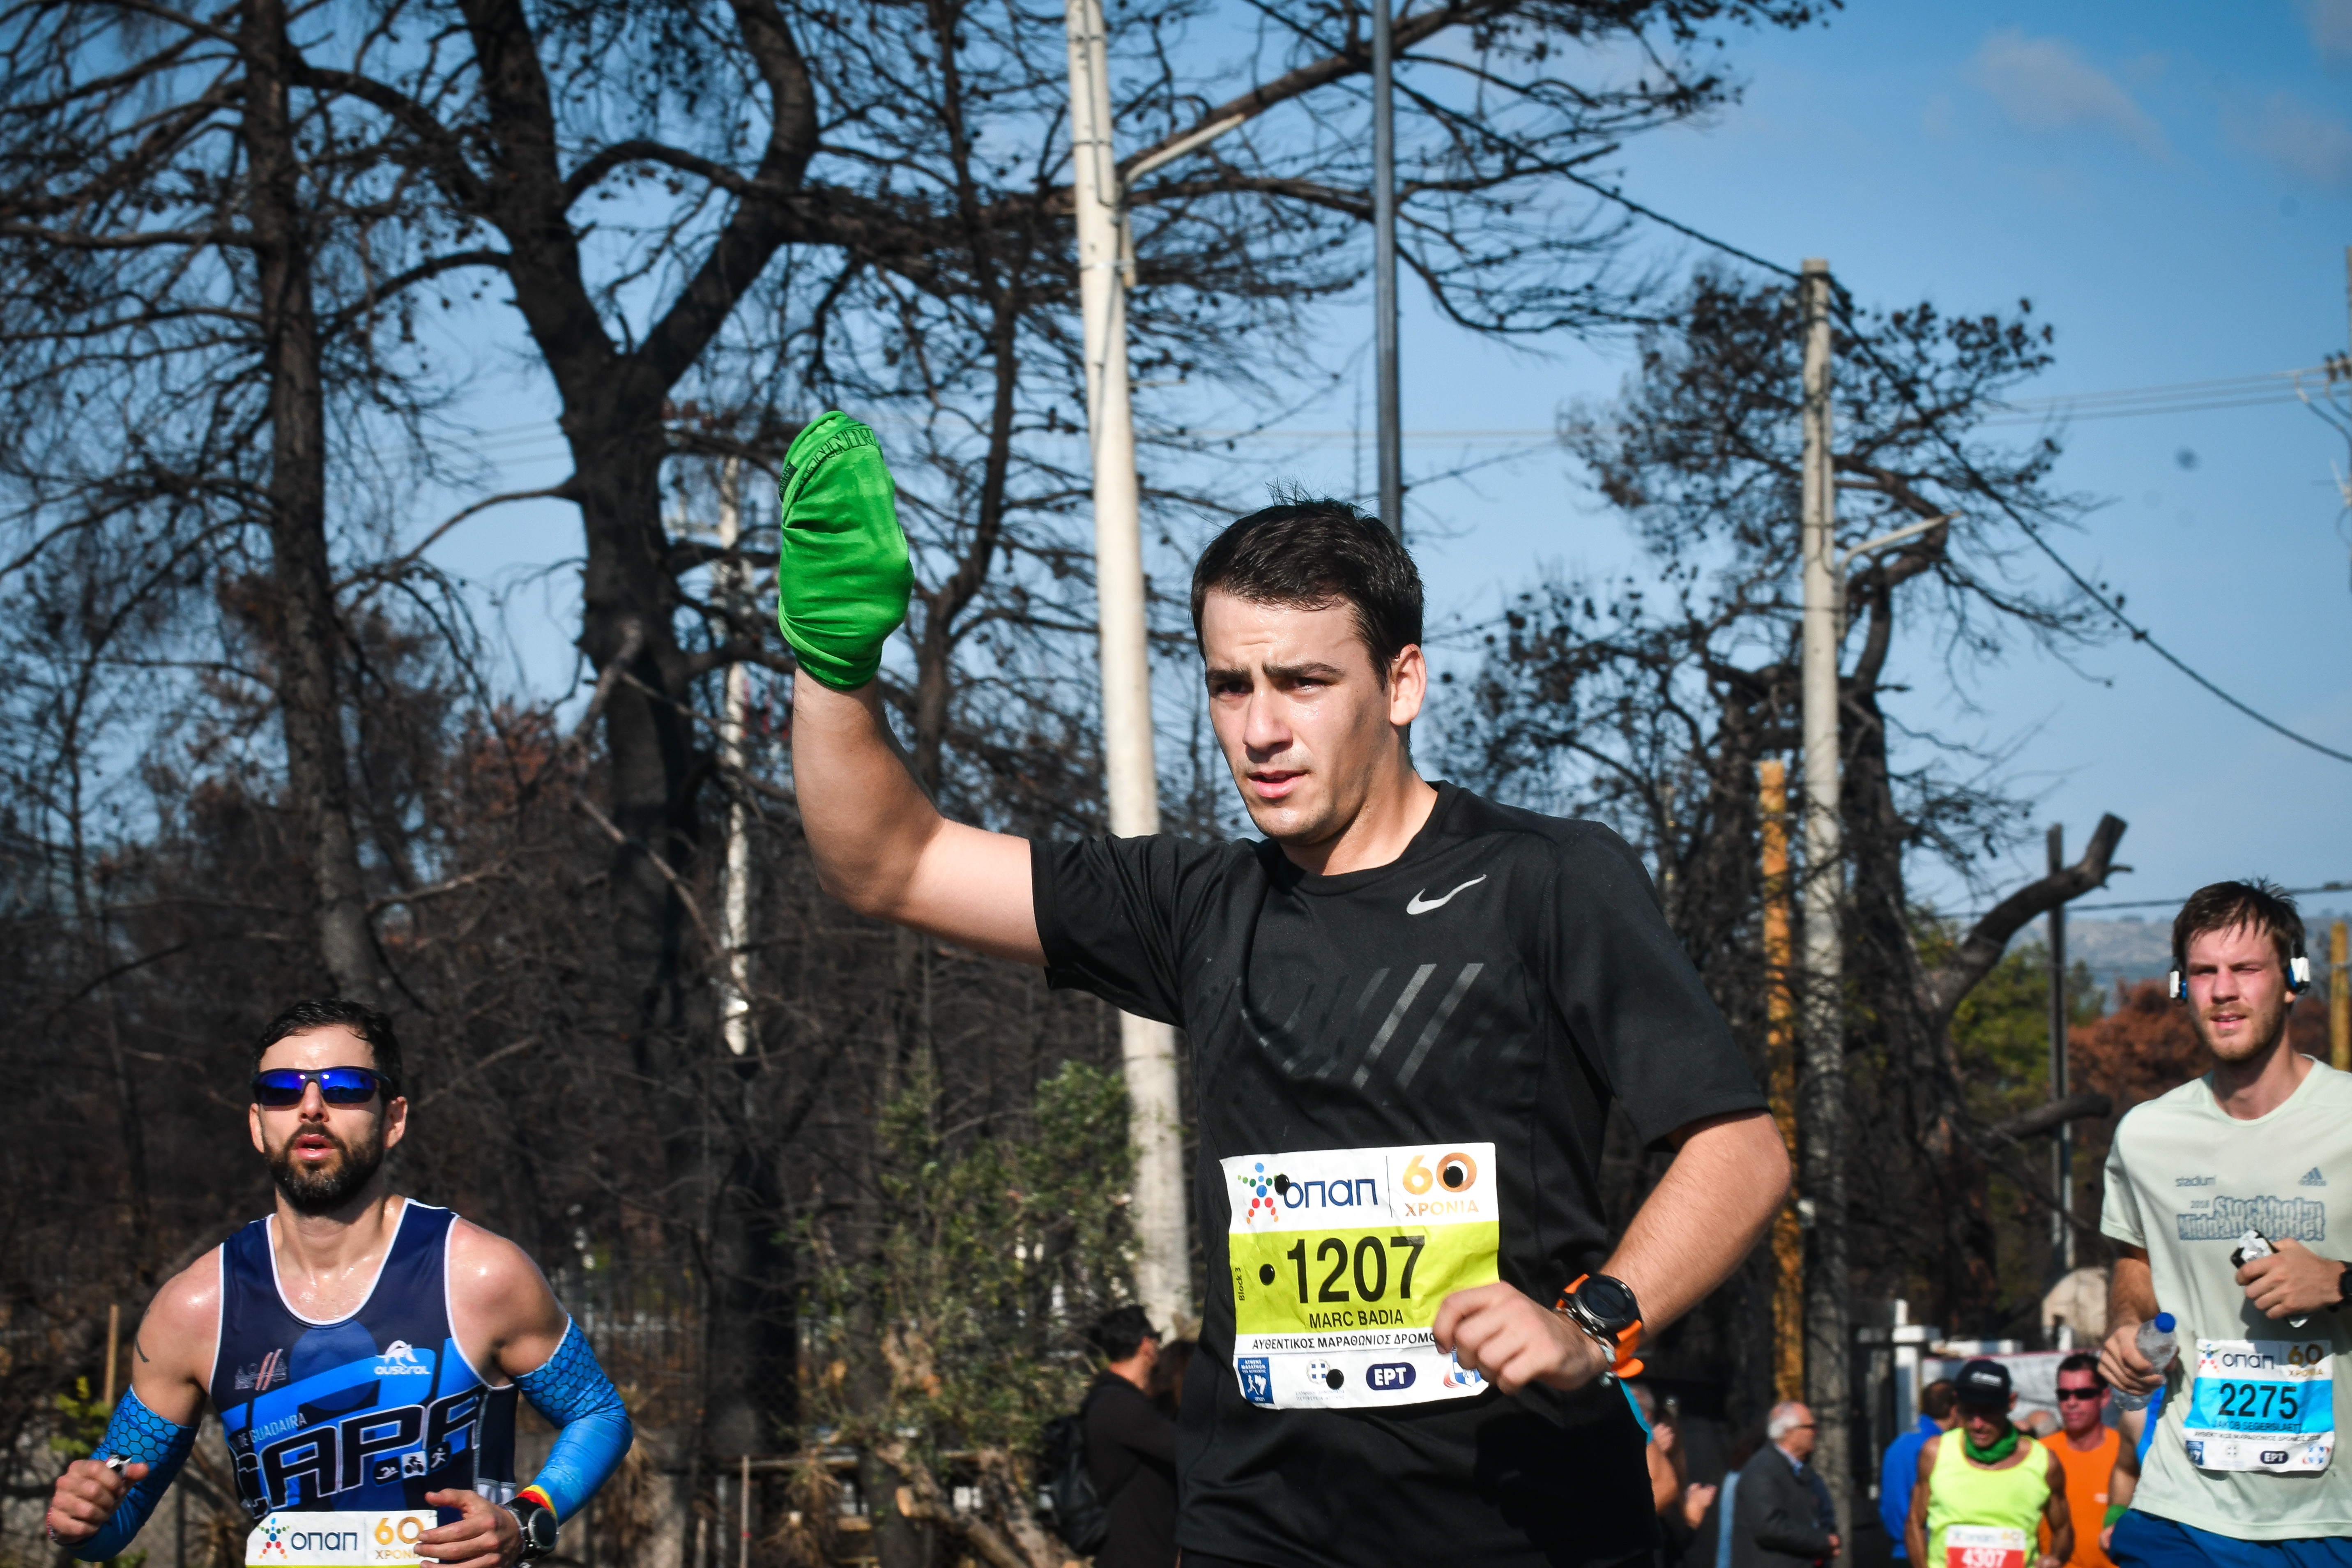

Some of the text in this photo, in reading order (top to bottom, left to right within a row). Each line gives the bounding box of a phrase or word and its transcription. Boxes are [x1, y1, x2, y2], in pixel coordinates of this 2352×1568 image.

[1402, 1152, 1477, 1195] 60
[1286, 1234, 1426, 1304] 1207
[1236, 1274, 1245, 1301] Block
[1309, 1308, 1404, 1329] MARC BADIA
[1394, 1332, 1436, 1344] ΔΡΟΜΟ
[2288, 1344, 2324, 1366] 60
[2218, 1383, 2299, 1419] 2275
[249, 1412, 308, 1443] GUADAIRA
[375, 1516, 425, 1545] 60
